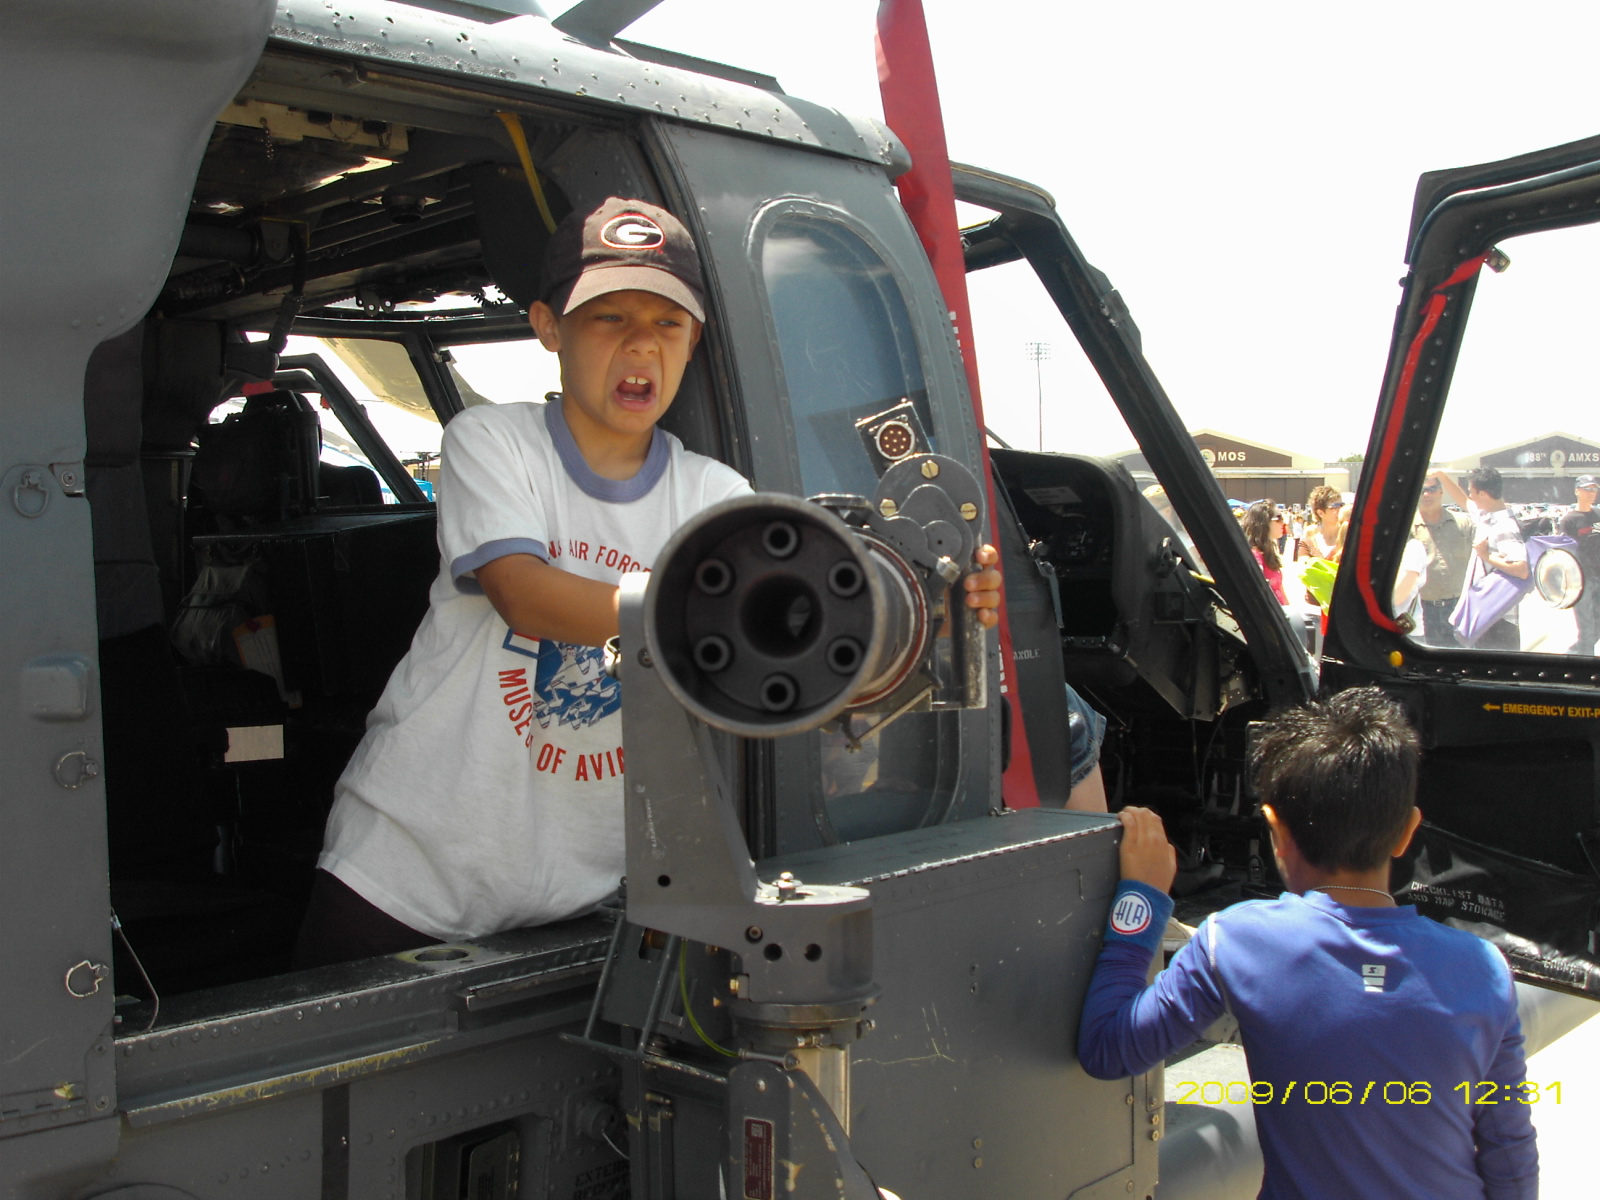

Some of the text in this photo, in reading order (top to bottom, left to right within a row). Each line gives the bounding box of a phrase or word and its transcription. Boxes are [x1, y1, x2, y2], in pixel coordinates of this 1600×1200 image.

[1217, 451, 1246, 462] MOS
[1568, 452, 1600, 463] AMXS
[569, 539, 589, 561] AIR
[595, 545, 653, 574] FORC
[1502, 703, 1565, 717] EMERGENCY
[536, 743, 567, 774] OF
